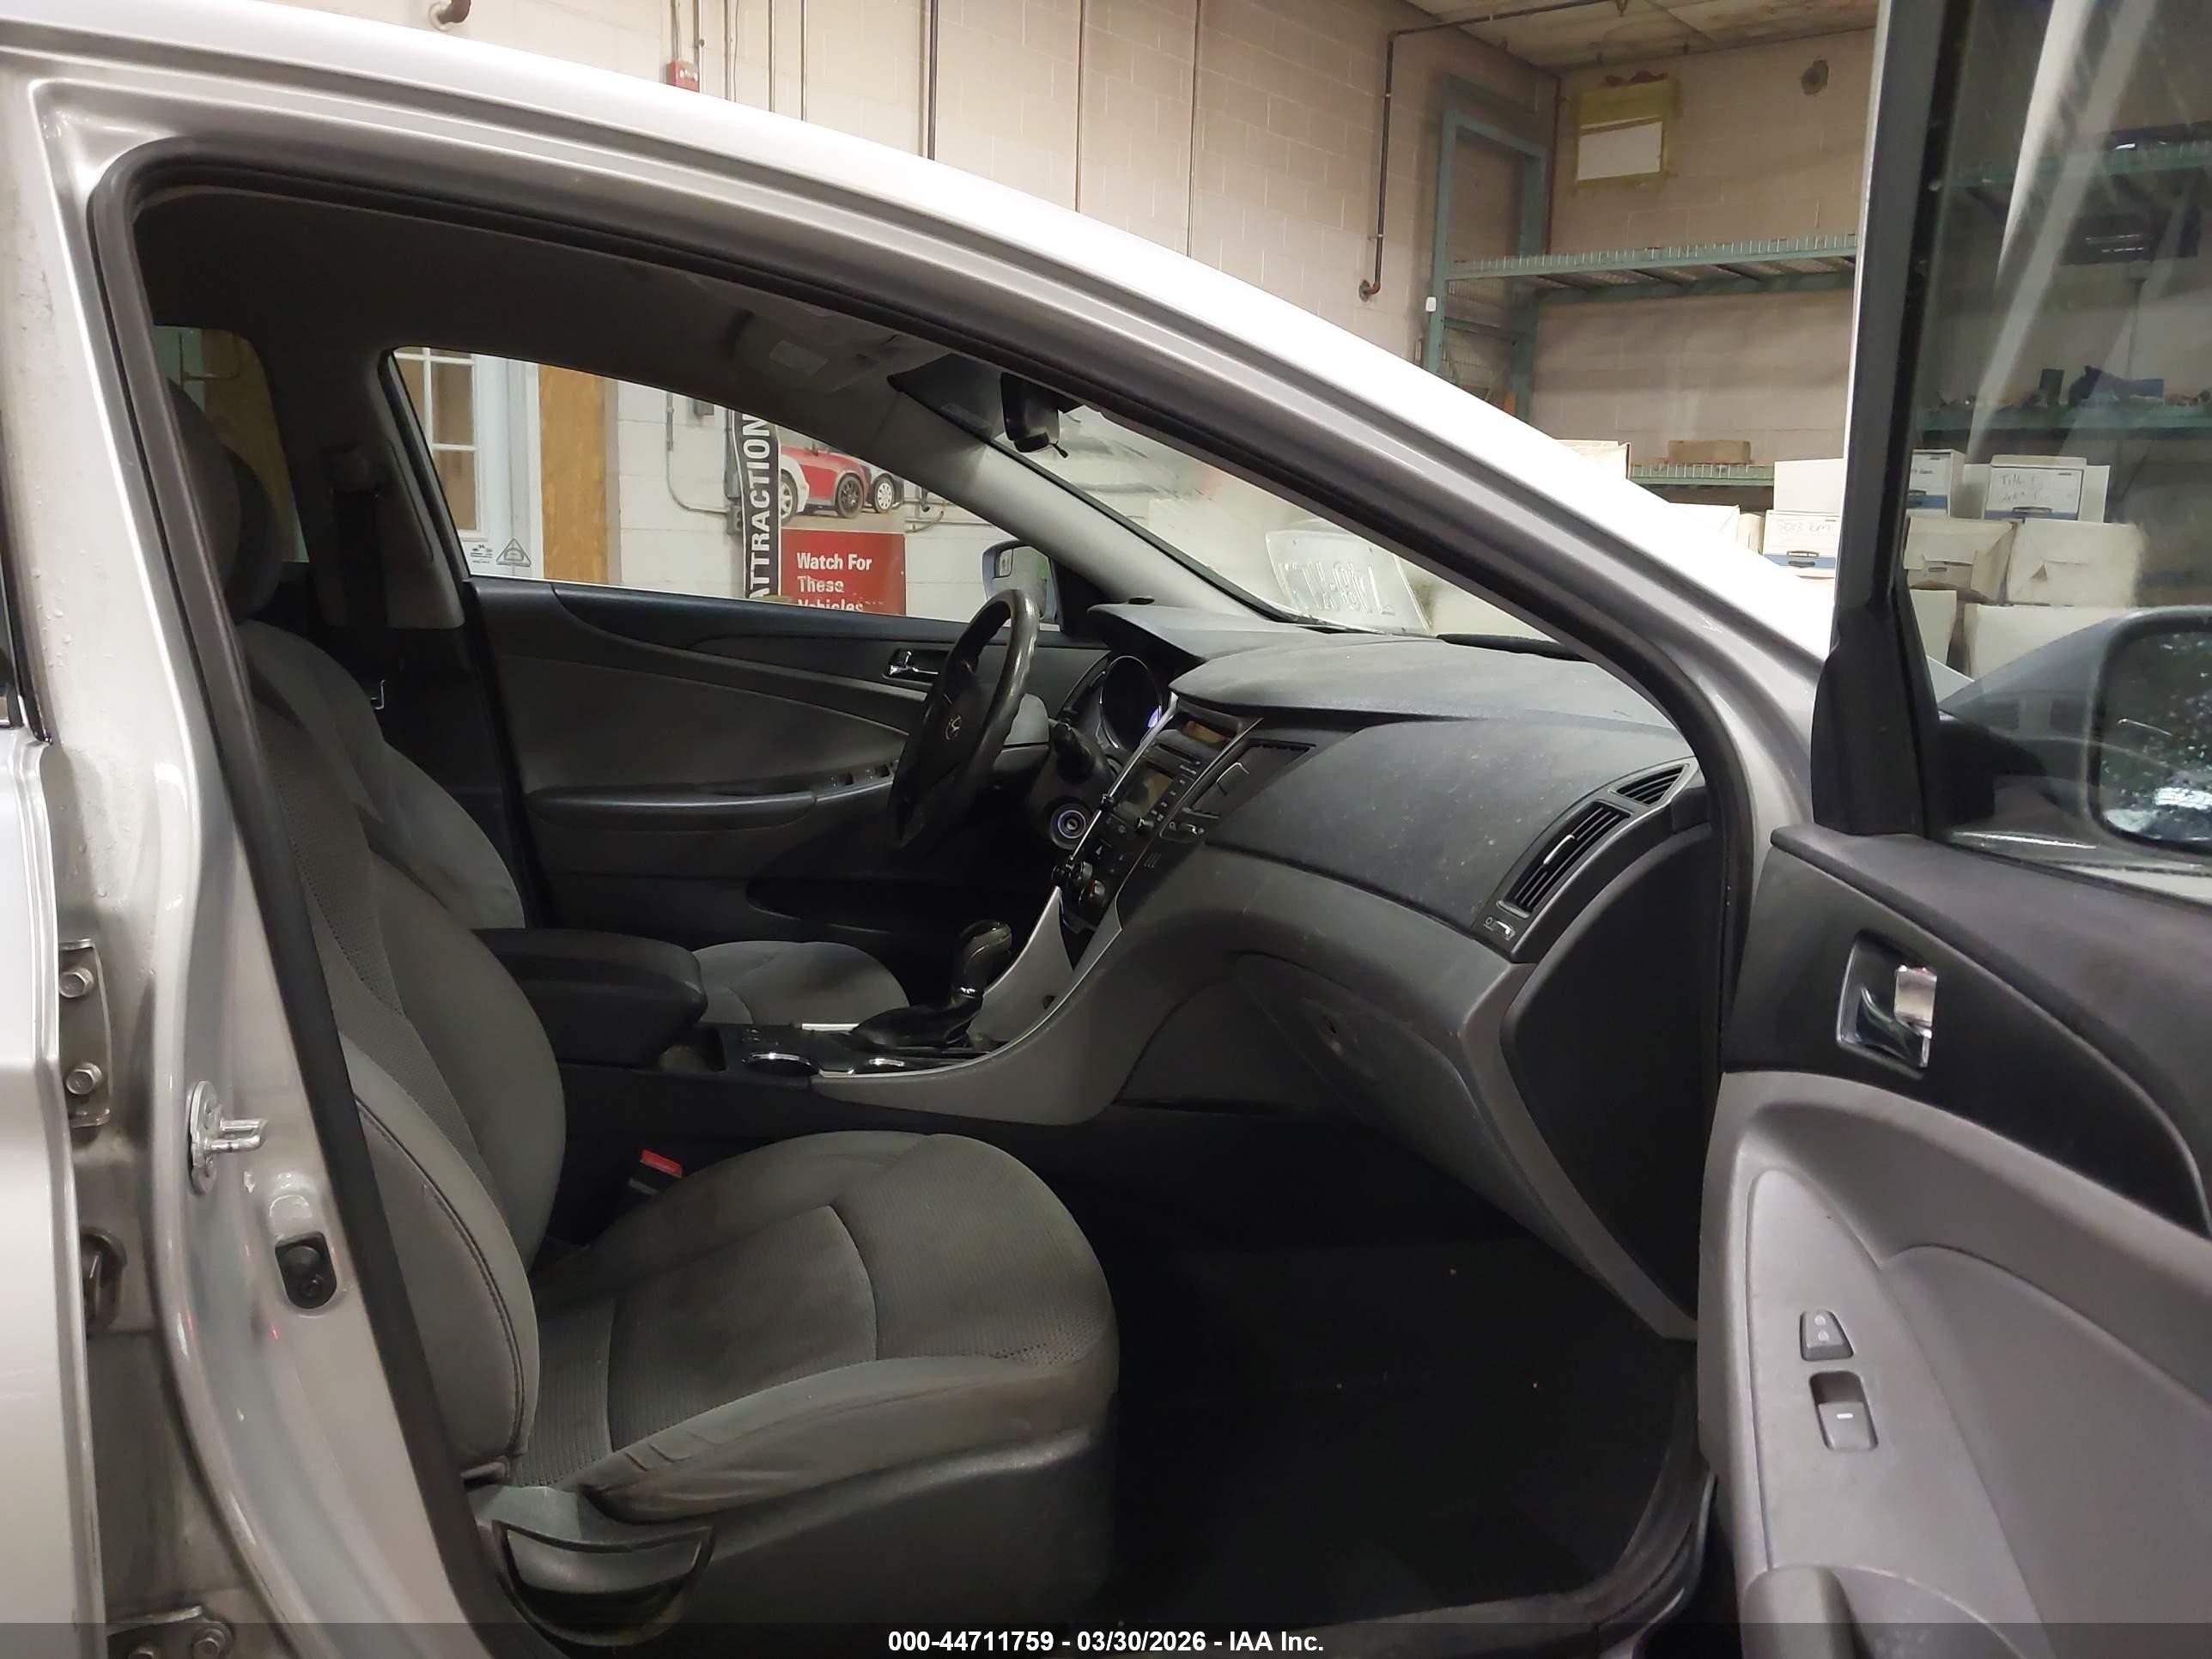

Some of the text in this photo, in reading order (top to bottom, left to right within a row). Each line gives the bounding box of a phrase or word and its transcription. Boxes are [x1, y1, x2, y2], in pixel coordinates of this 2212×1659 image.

[796, 552, 873, 571] Watch For
[796, 574, 845, 593] These
